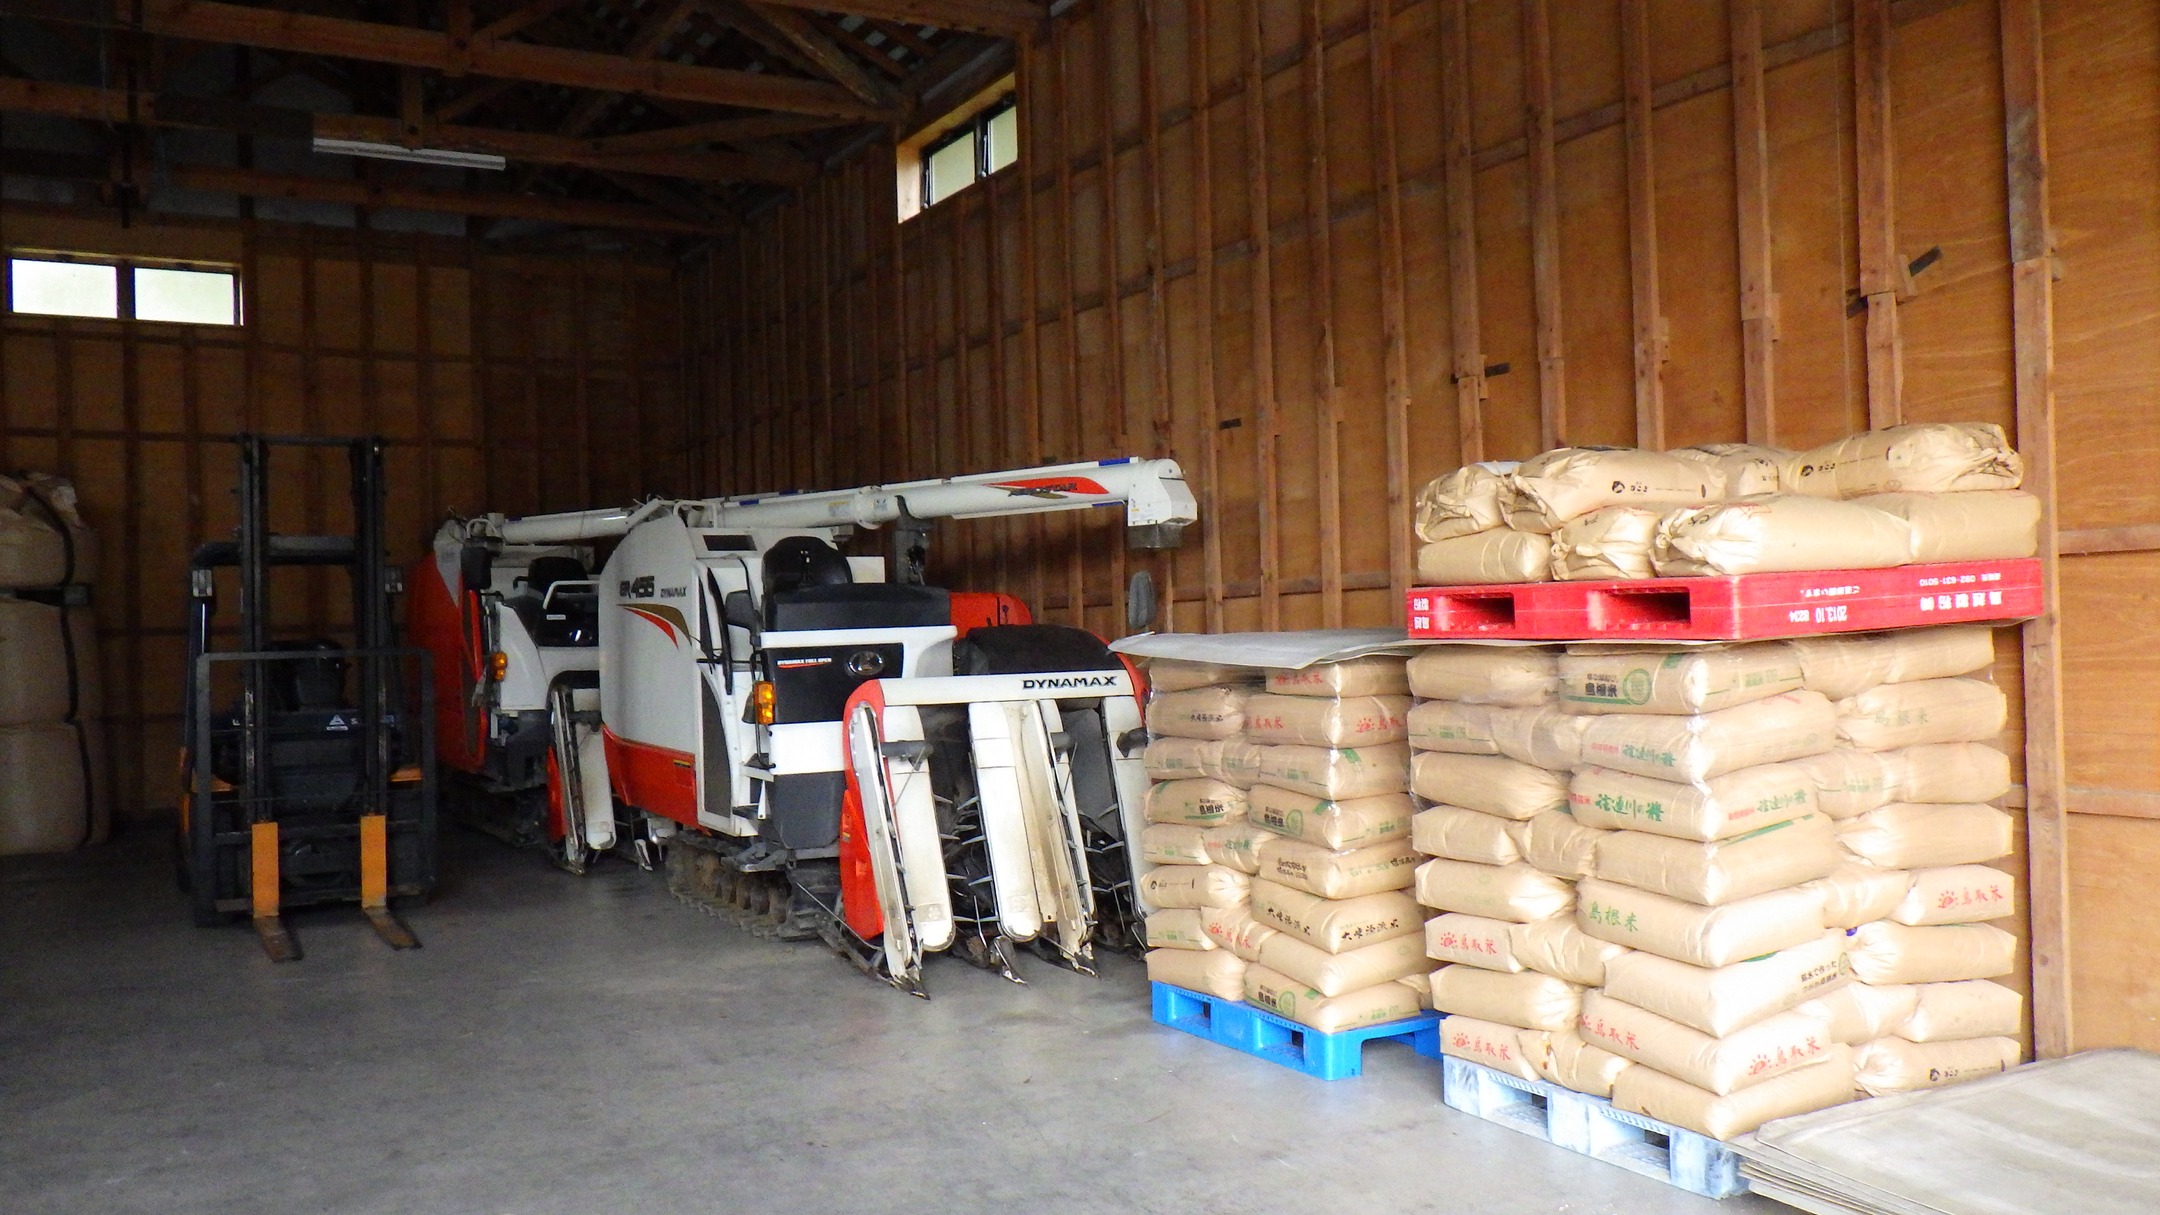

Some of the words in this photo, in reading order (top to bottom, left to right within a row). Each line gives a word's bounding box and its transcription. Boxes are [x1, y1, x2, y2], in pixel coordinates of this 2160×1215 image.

[1815, 605, 1848, 623] 2013.10
[1022, 676, 1118, 689] DYNAMAX
[1960, 884, 2003, 905] 鳥取米
[1589, 901, 1639, 933] 島根米
[1461, 933, 1498, 955] 鳥取米
[1594, 1019, 1640, 1050] 鳥取米
[1473, 1036, 1512, 1061] 鳥取米
[1777, 1036, 1822, 1064] 鳥取米
